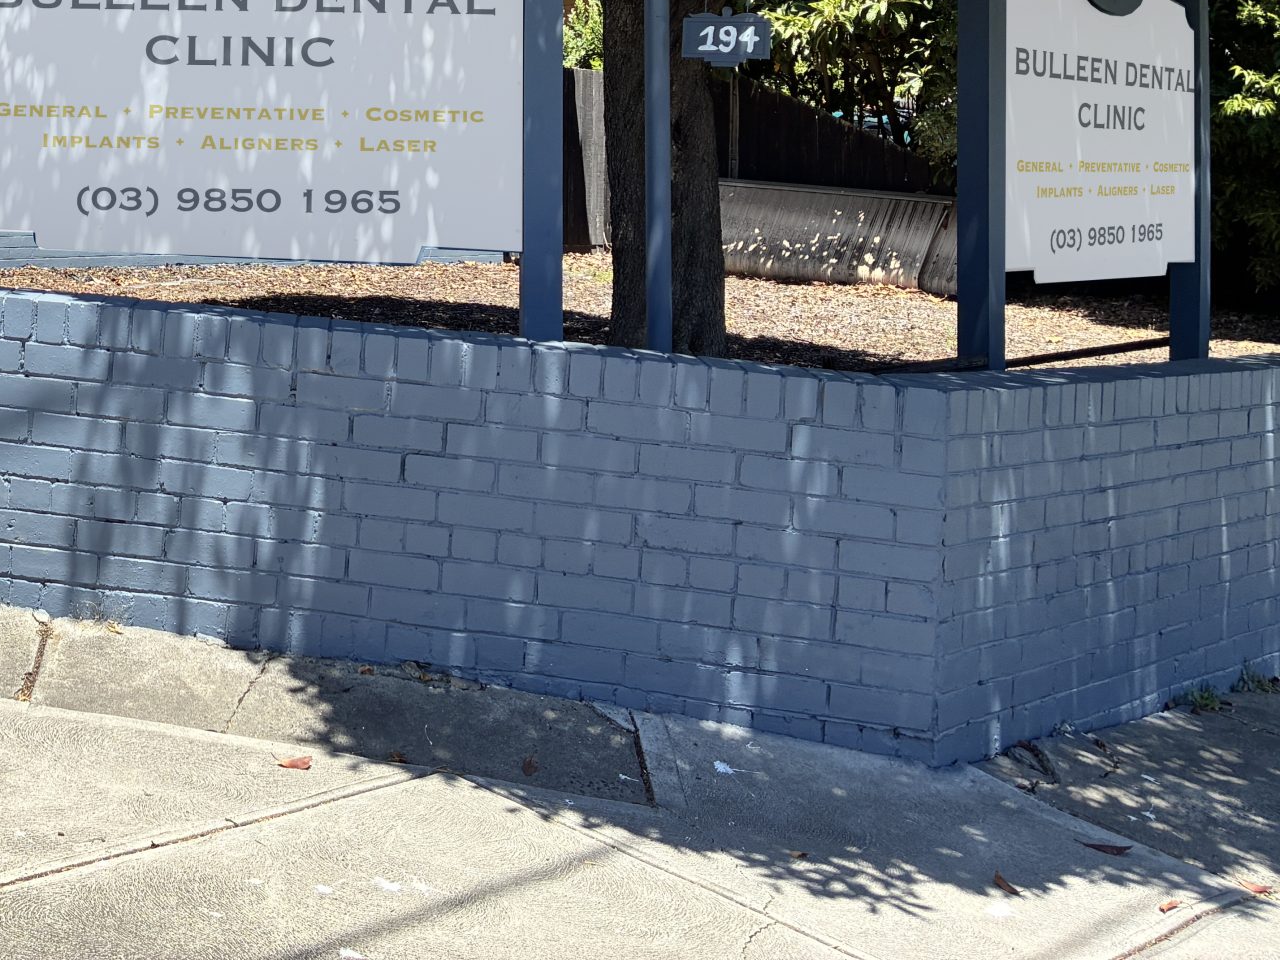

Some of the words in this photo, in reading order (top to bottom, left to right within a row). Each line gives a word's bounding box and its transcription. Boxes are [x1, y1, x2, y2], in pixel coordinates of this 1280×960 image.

[145, 35, 335, 67] CLINIC
[697, 25, 760, 53] 194
[1015, 47, 1118, 84] BULLEEN
[1125, 61, 1195, 93] DENTAL
[149, 104, 325, 121] PREVENTATIVE
[365, 107, 485, 123] COSMETIC
[1078, 102, 1145, 131] CLINIC
[41, 133, 160, 149] IMPLANTS
[200, 135, 319, 151] ALIGNERS
[360, 137, 437, 152] LASER
[1017, 159, 1063, 173] GENERAL
[1078, 160, 1140, 173] PREVENTATIVE
[76, 185, 159, 218] (03)
[177, 188, 282, 213] 9850
[303, 189, 401, 214] 1965
[1036, 186, 1083, 198] IMPLANTS
[1097, 185, 1138, 197] ALIGNERS
[1150, 184, 1175, 195] LASER
[1050, 228, 1082, 254] (03)
[1088, 225, 1125, 246] 9850
[1131, 223, 1163, 243] 1965
